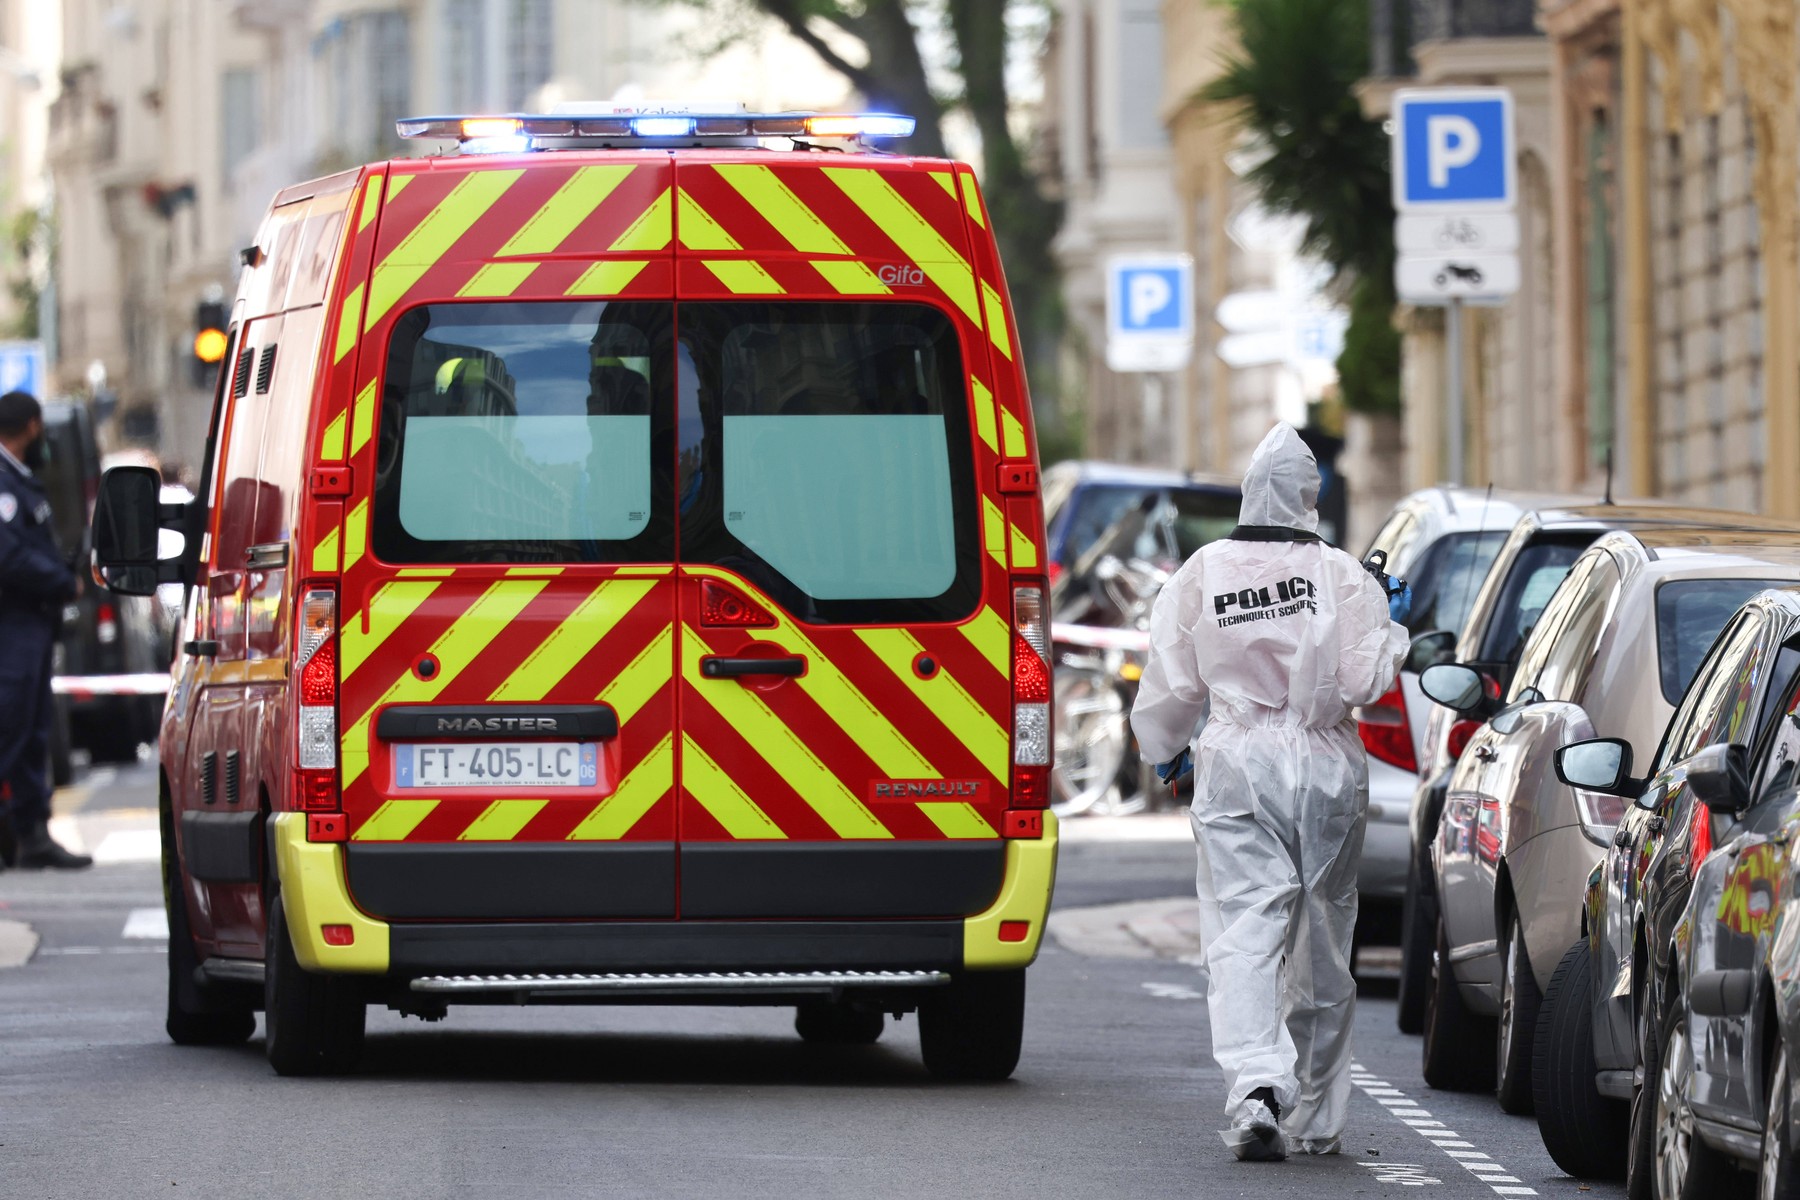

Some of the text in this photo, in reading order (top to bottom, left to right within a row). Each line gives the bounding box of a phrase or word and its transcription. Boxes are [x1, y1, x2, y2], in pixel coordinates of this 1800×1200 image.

[1427, 114, 1481, 188] P
[878, 264, 924, 285] Gifa
[1129, 273, 1172, 325] P
[1214, 577, 1318, 615] POLICE
[1217, 610, 1266, 628] TECHNIQUE
[1265, 609, 1276, 620] ET
[438, 718, 557, 731] MASTER
[402, 747, 596, 779] F FT-405-LC 06
[876, 782, 980, 797] RENAULT
